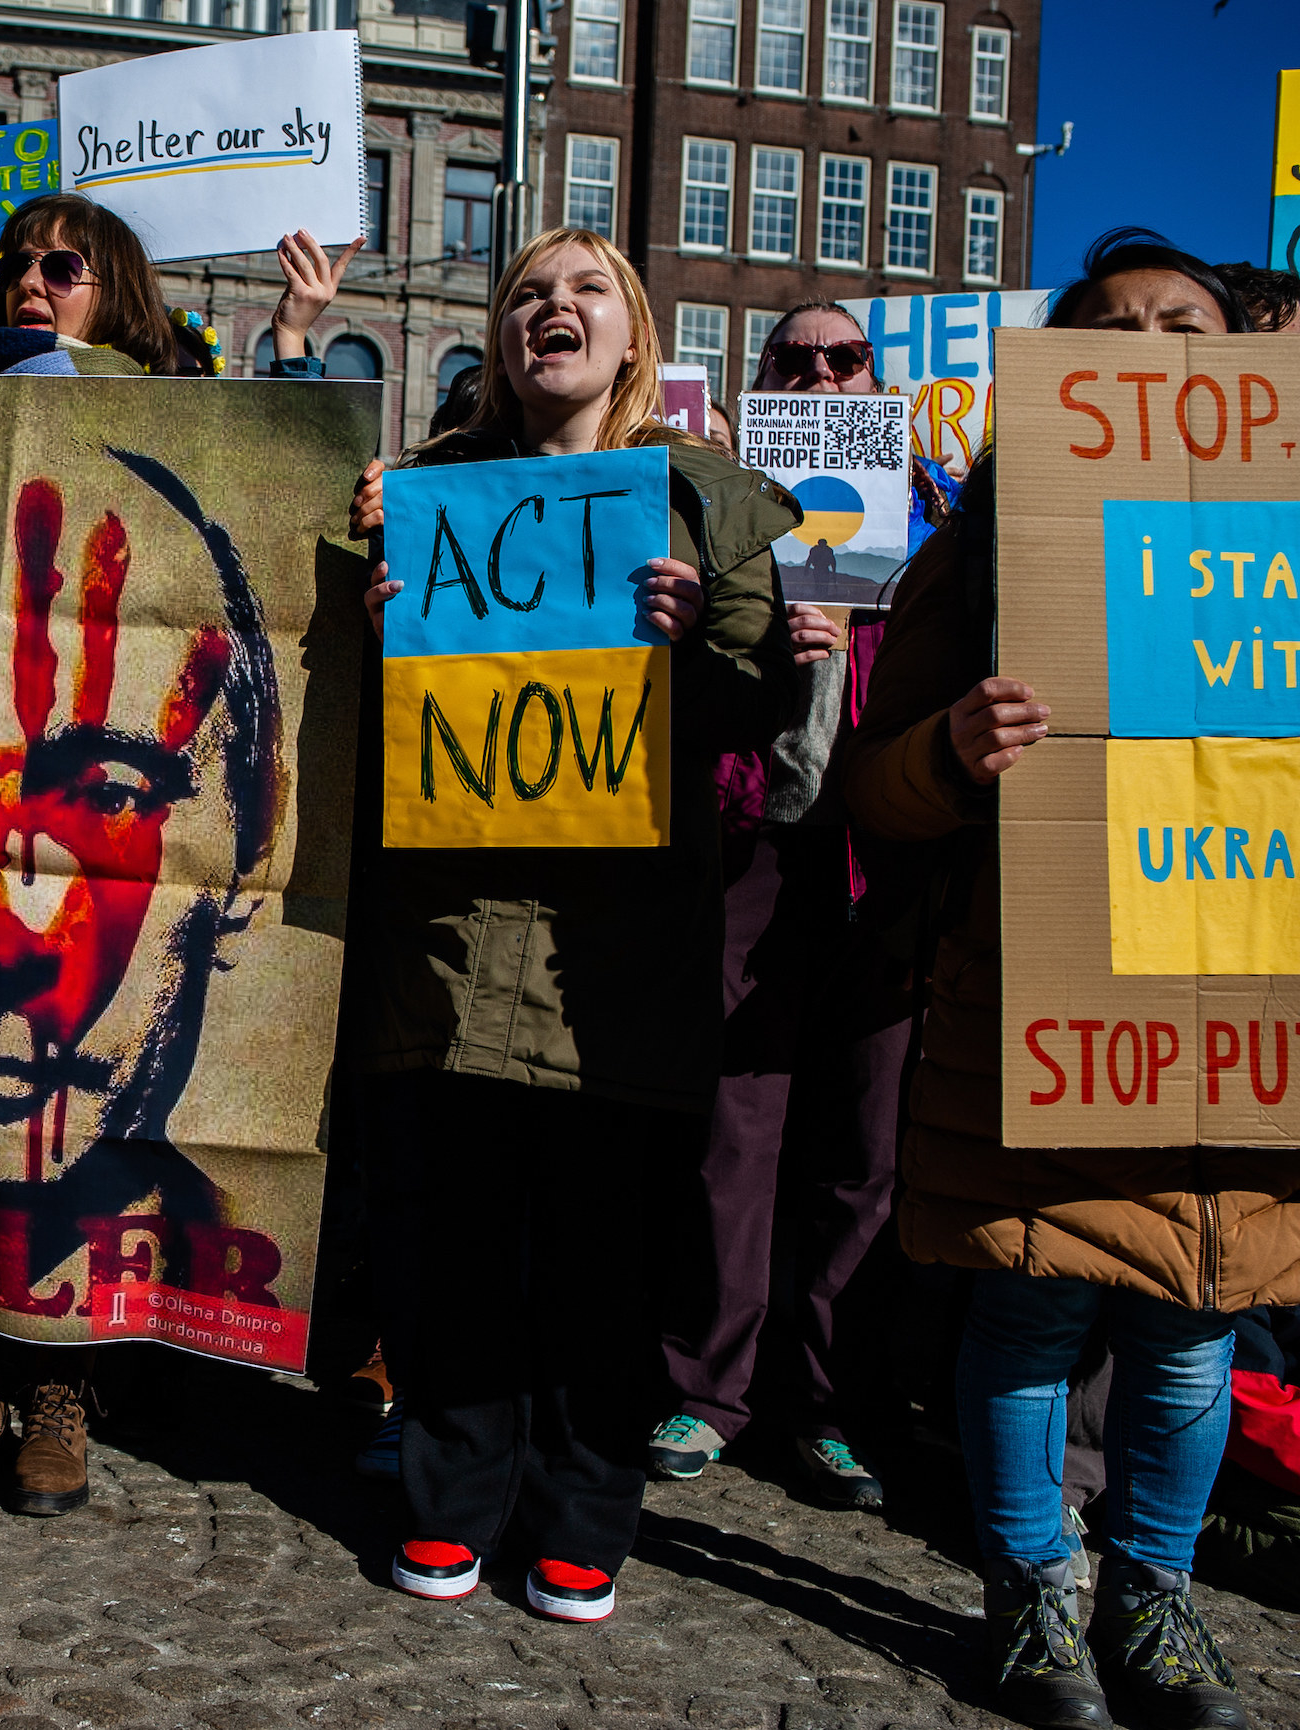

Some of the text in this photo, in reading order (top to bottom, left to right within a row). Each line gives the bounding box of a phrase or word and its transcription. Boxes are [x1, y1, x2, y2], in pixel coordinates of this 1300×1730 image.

[72, 107, 331, 176] Shelter our sky
[746, 418, 821, 429] UKRAINIAN ARMY
[747, 399, 821, 417] SUPPORT
[1059, 370, 1279, 462] STOP
[746, 430, 821, 446] TO DEFEND
[746, 447, 820, 469] EUROPE
[420, 489, 632, 621] ACT
[420, 677, 652, 809] NOW
[1138, 826, 1295, 883] UKRA
[1025, 1018, 1300, 1106] STOP PU
[147, 1315, 264, 1355] durdom.in.ua
[222, 1310, 282, 1333] Dnipro
